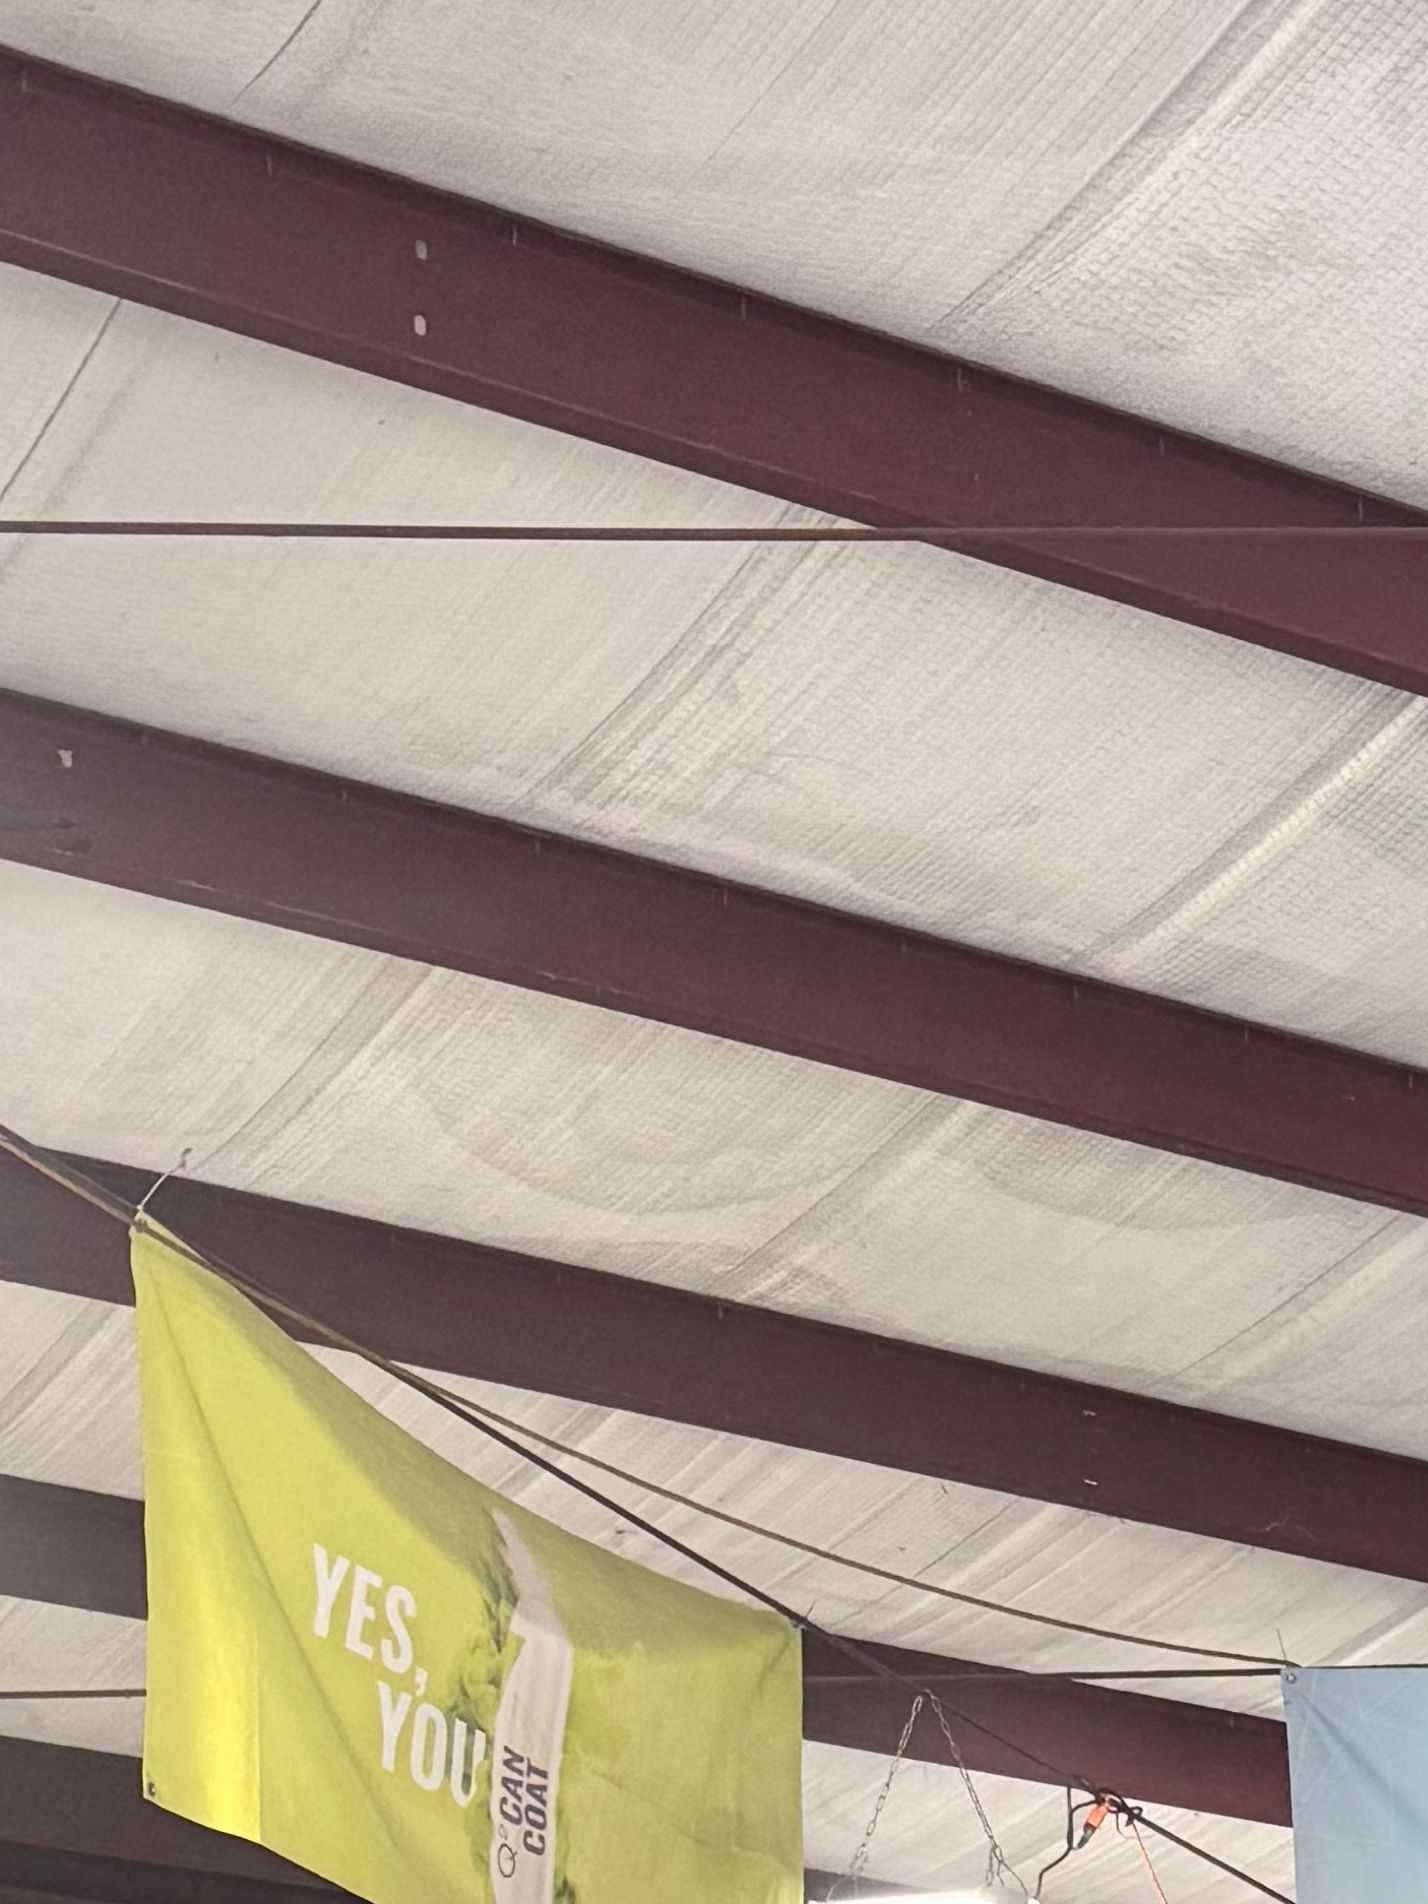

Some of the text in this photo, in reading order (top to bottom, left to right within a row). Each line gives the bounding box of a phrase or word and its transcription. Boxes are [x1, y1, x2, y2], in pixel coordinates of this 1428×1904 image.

[313, 1542, 427, 1697] YES,
[377, 1679, 487, 1808] YOU
[500, 1745, 525, 1825] CAN
[523, 1757, 548, 1856] COAT
